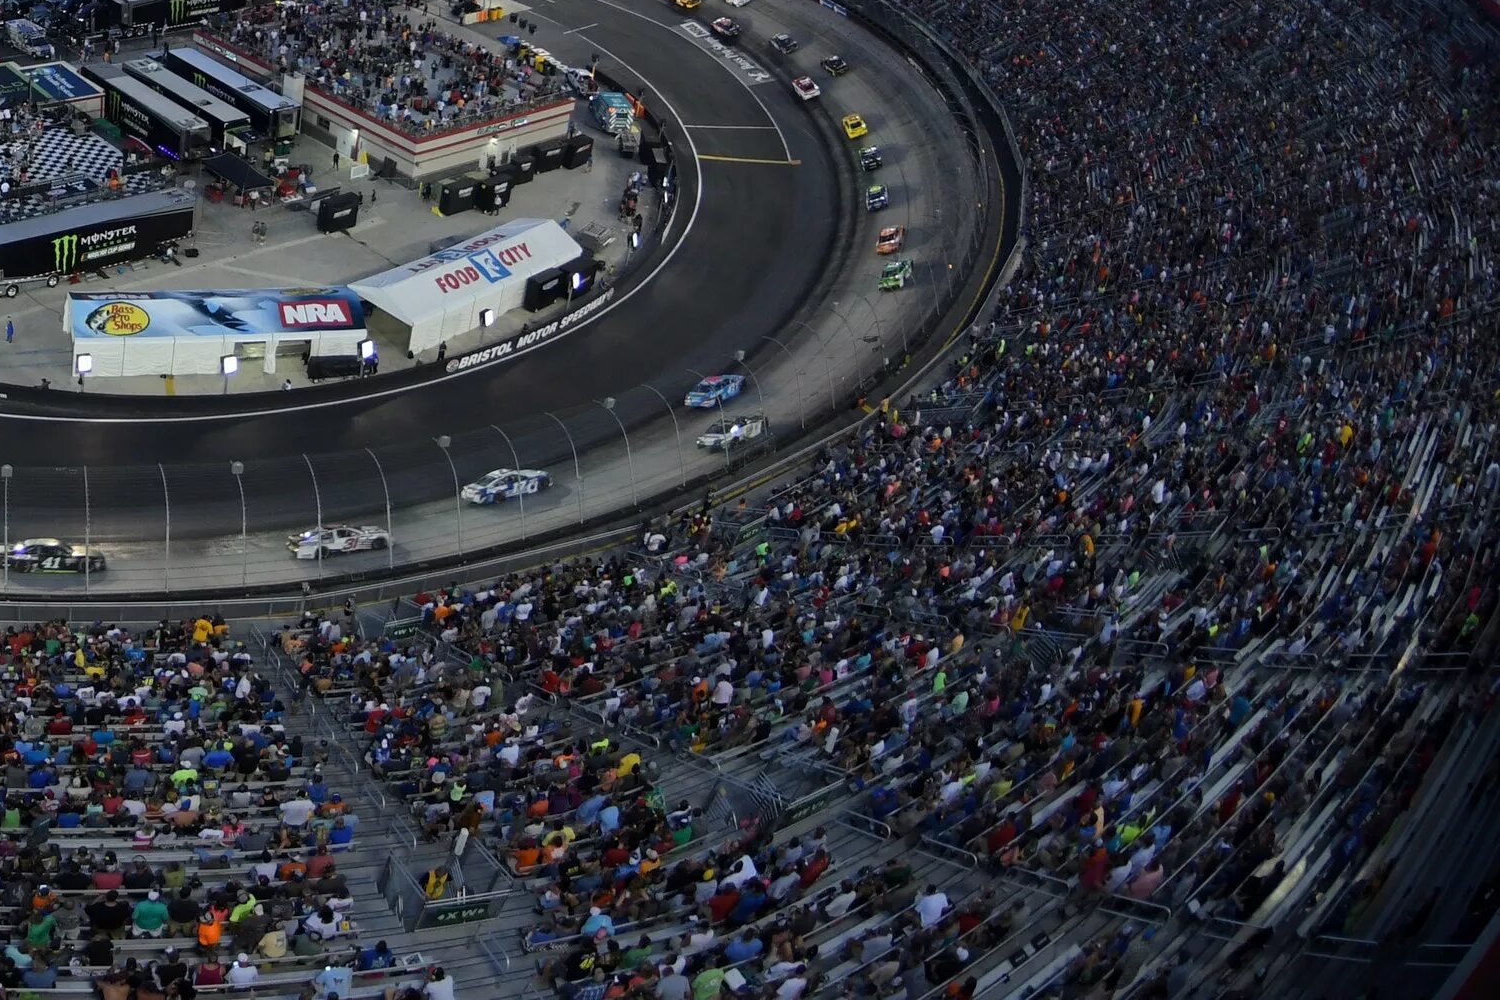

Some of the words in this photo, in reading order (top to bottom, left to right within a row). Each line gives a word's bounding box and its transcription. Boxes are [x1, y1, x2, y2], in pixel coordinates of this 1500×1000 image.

[80, 224, 137, 246] MONSTER
[108, 246, 118, 256] CUP
[118, 241, 137, 253] SERIES
[435, 266, 480, 294] FOOD
[498, 242, 533, 267] CITY
[111, 304, 135, 315] Bass
[282, 303, 348, 325] NRA
[111, 312, 130, 323] Pro
[112, 320, 143, 333] Shops
[458, 341, 513, 370] BRISTOL
[517, 322, 558, 348] MOTOR
[560, 293, 608, 330] SPEEDWAY
[41, 556, 61, 569] 41
[447, 911, 460, 920] X
[462, 908, 478, 918] W
